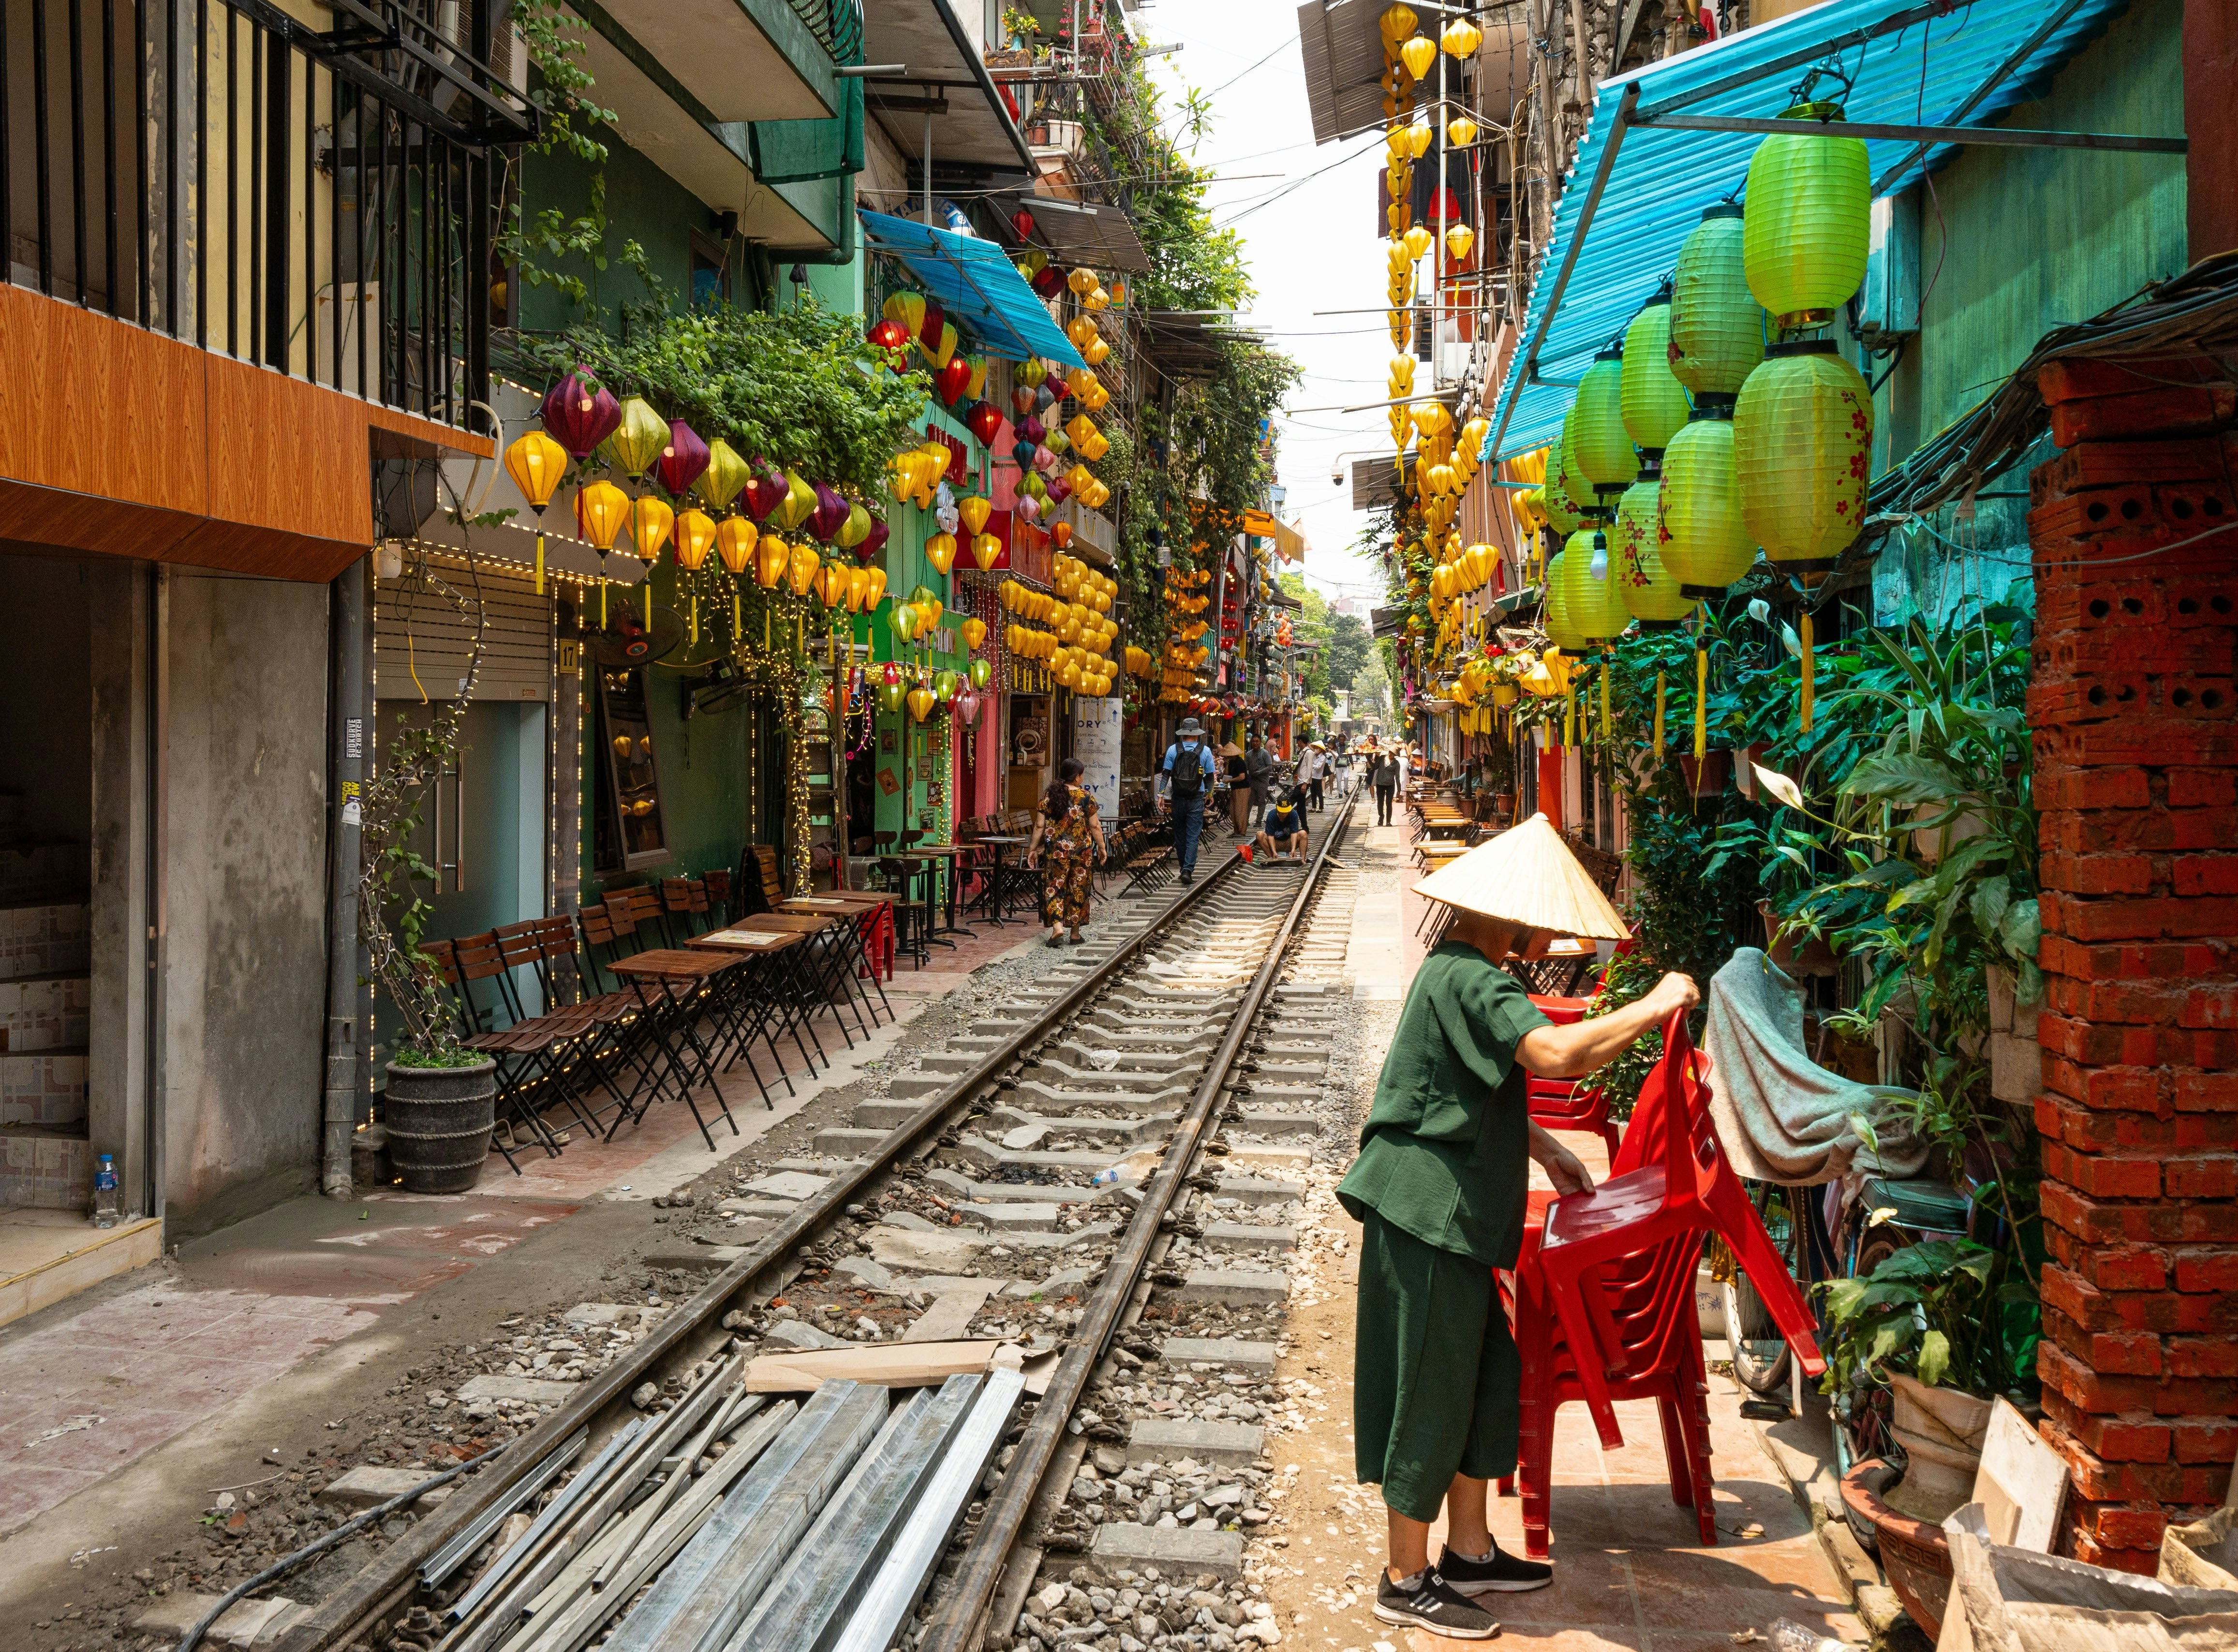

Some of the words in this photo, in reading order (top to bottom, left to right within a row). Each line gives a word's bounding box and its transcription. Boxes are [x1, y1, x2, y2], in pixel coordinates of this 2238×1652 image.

[563, 646, 574, 667] 17
[347, 719, 356, 758] SÜDKURVE
[1080, 785, 1099, 793] RY
